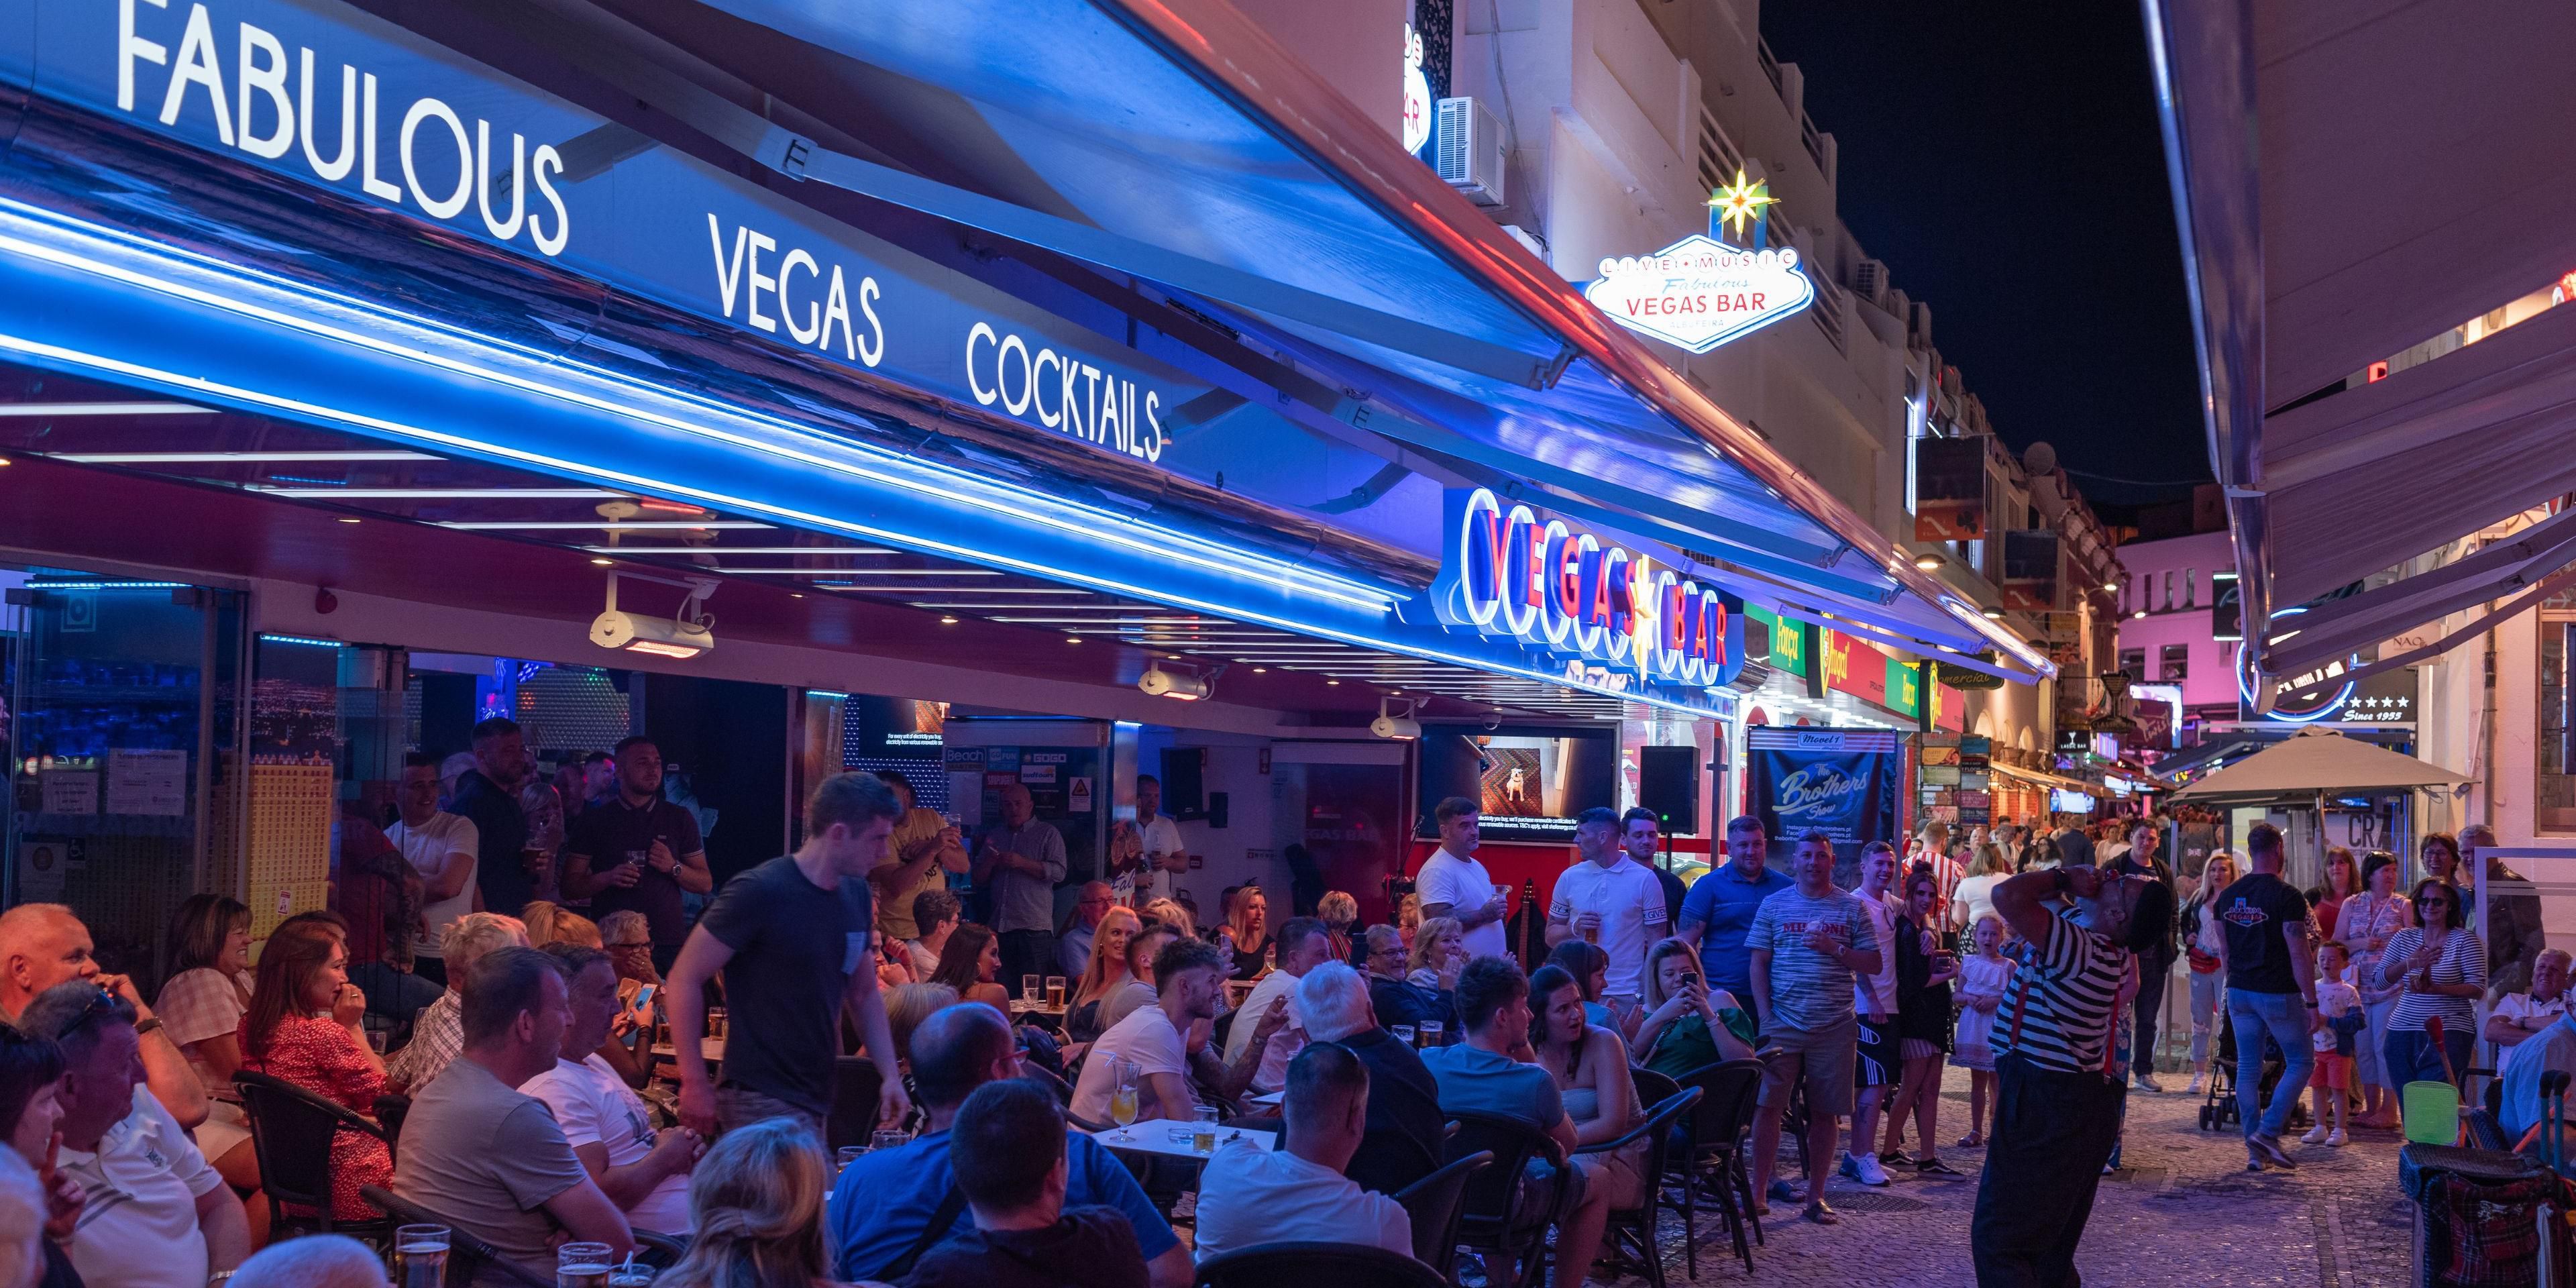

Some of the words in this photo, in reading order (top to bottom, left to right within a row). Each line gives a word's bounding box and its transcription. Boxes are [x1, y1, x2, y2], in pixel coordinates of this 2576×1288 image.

[116, 0, 570, 256] FABULOUS
[708, 213, 884, 368] VEGAS
[966, 322, 1161, 463] COCKTAILS
[1627, 295, 1707, 316] VEGAS
[1717, 292, 1766, 312] BAR
[1484, 509, 1636, 637] VEGAS
[1670, 584, 1727, 666] BAR
[1938, 673, 1991, 684] omercial
[2342, 710, 2373, 722] Since
[2377, 712, 2403, 720] 1955
[947, 749, 983, 761] Beach
[1034, 753, 1067, 763] GOGO
[1815, 763, 1831, 777] The
[1779, 770, 1868, 807] Brothers
[1806, 804, 1835, 820] Show
[1783, 922, 1847, 934] MIONI
